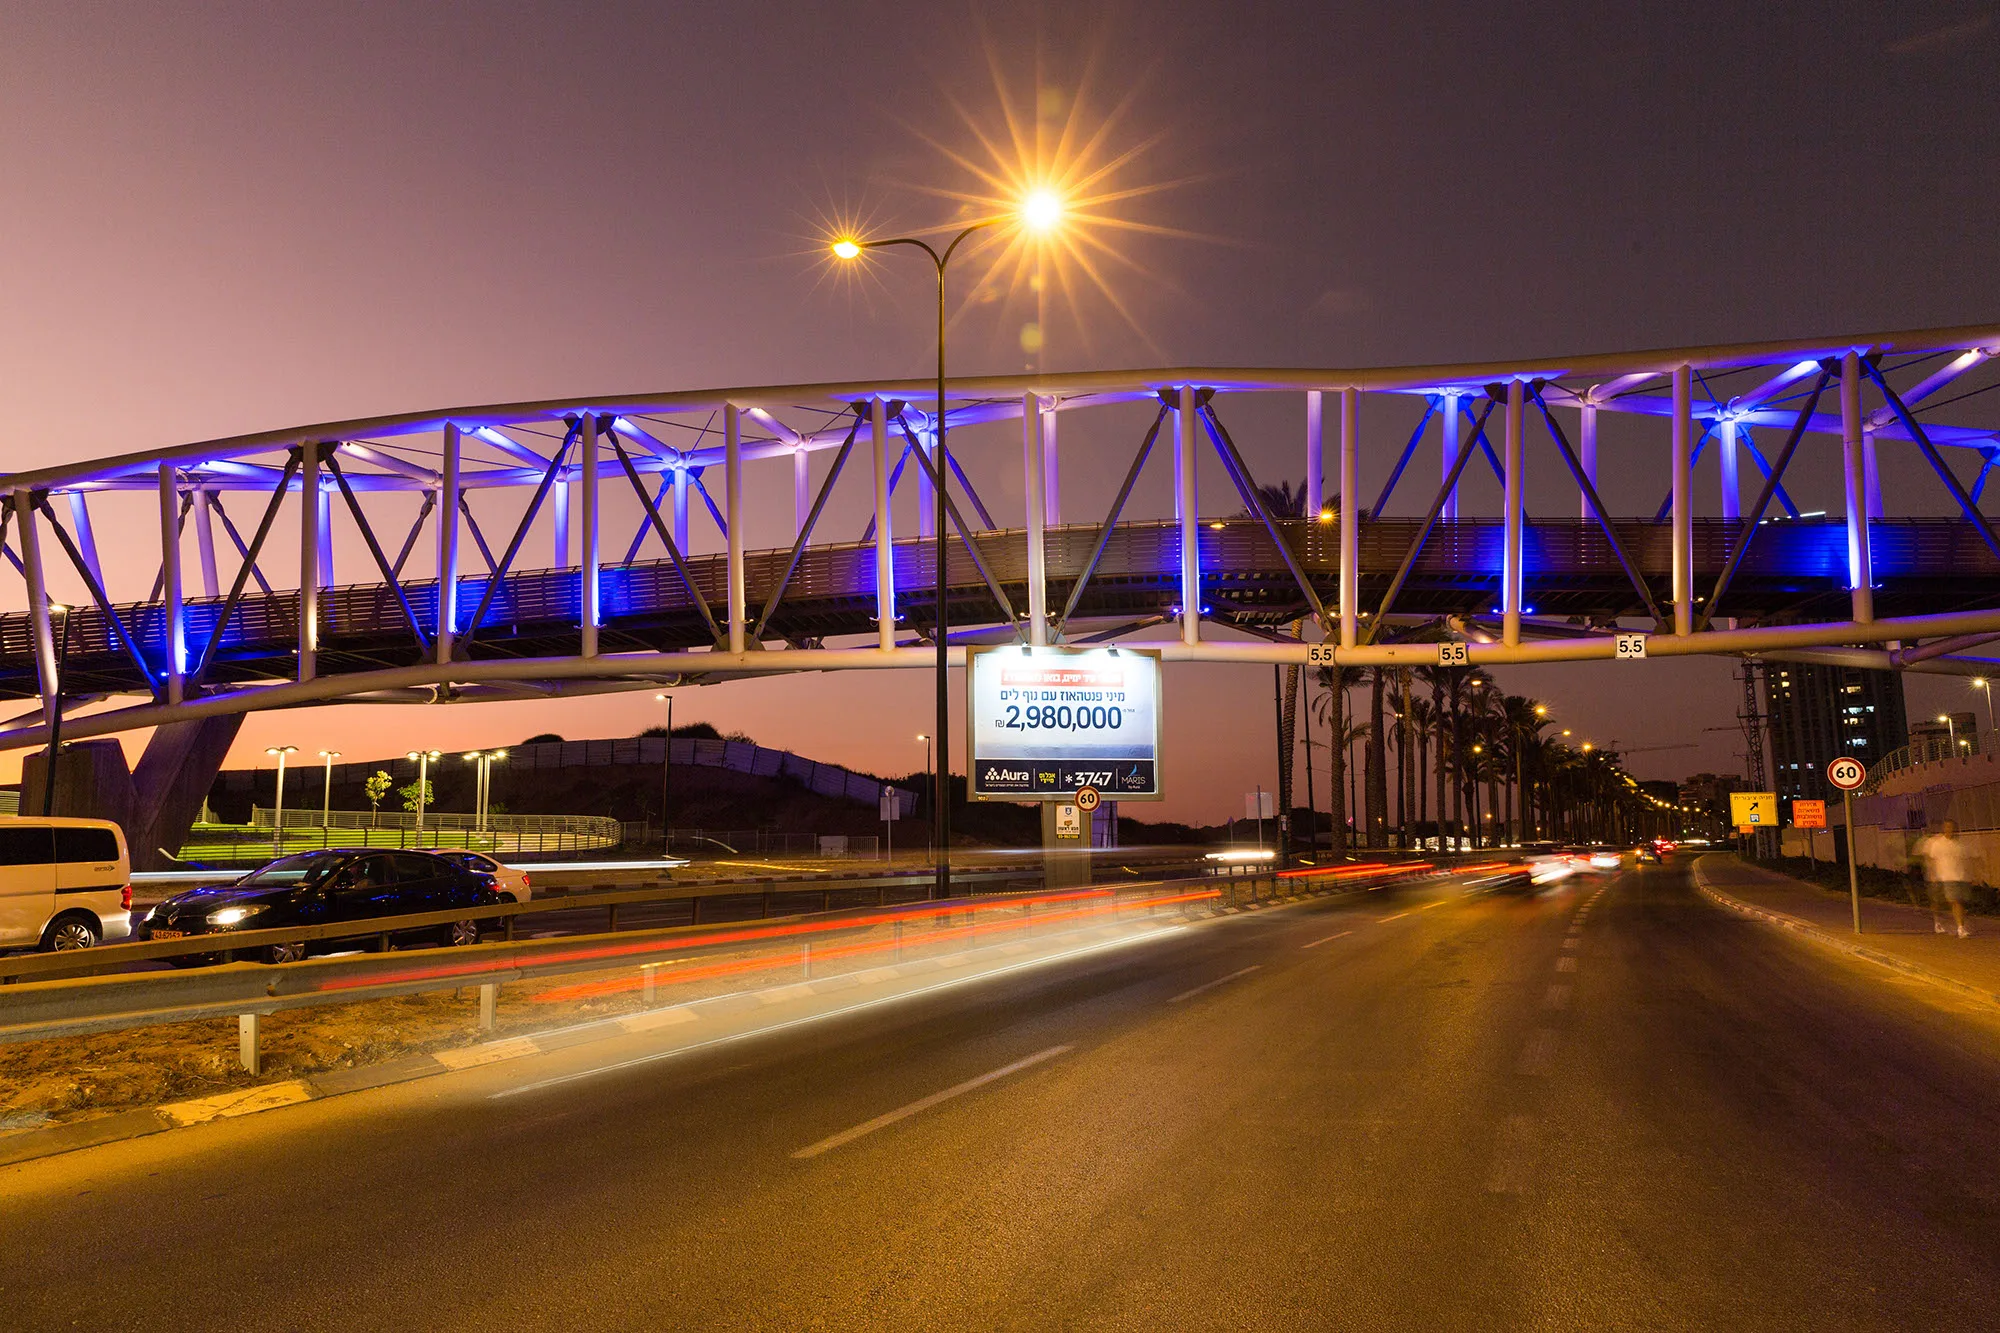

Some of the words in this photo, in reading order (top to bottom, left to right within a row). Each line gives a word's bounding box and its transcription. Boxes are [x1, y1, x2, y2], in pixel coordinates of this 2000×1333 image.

[1619, 640, 1642, 653] 5.5
[1311, 648, 1332, 660] 5.5
[1442, 647, 1464, 660] 5.5
[1001, 689, 1019, 700] לים
[1022, 691, 1038, 703] נוף
[1041, 690, 1057, 701] עם
[1060, 691, 1103, 701] פנטהאוז
[1106, 691, 1125, 701] מיני
[1005, 705, 1122, 732] 2,980,000
[1000, 769, 1029, 781] Aura
[1836, 766, 1857, 779] 60
[1121, 776, 1146, 785] MARIS
[1080, 794, 1095, 804] 60
